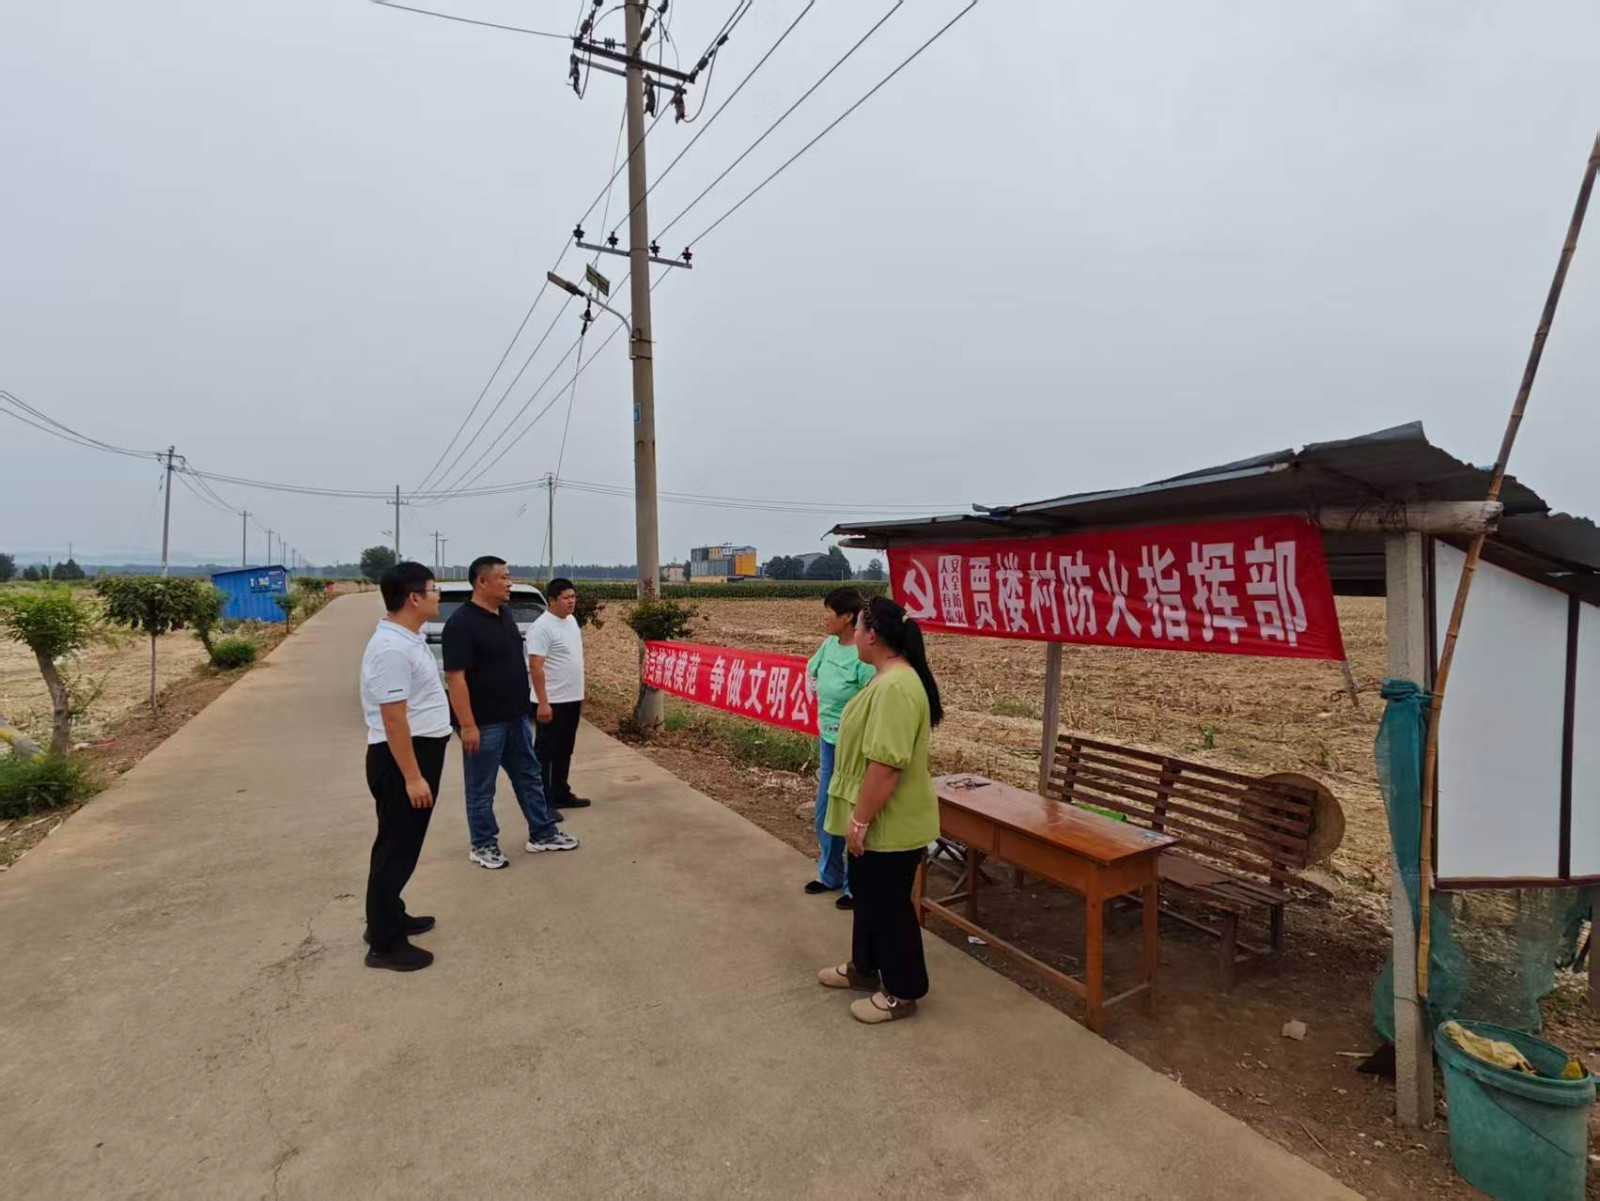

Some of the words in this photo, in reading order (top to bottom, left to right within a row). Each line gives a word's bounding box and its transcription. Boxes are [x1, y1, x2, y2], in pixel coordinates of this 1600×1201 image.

[969, 535, 1308, 647] 贾楼村防火指挥部
